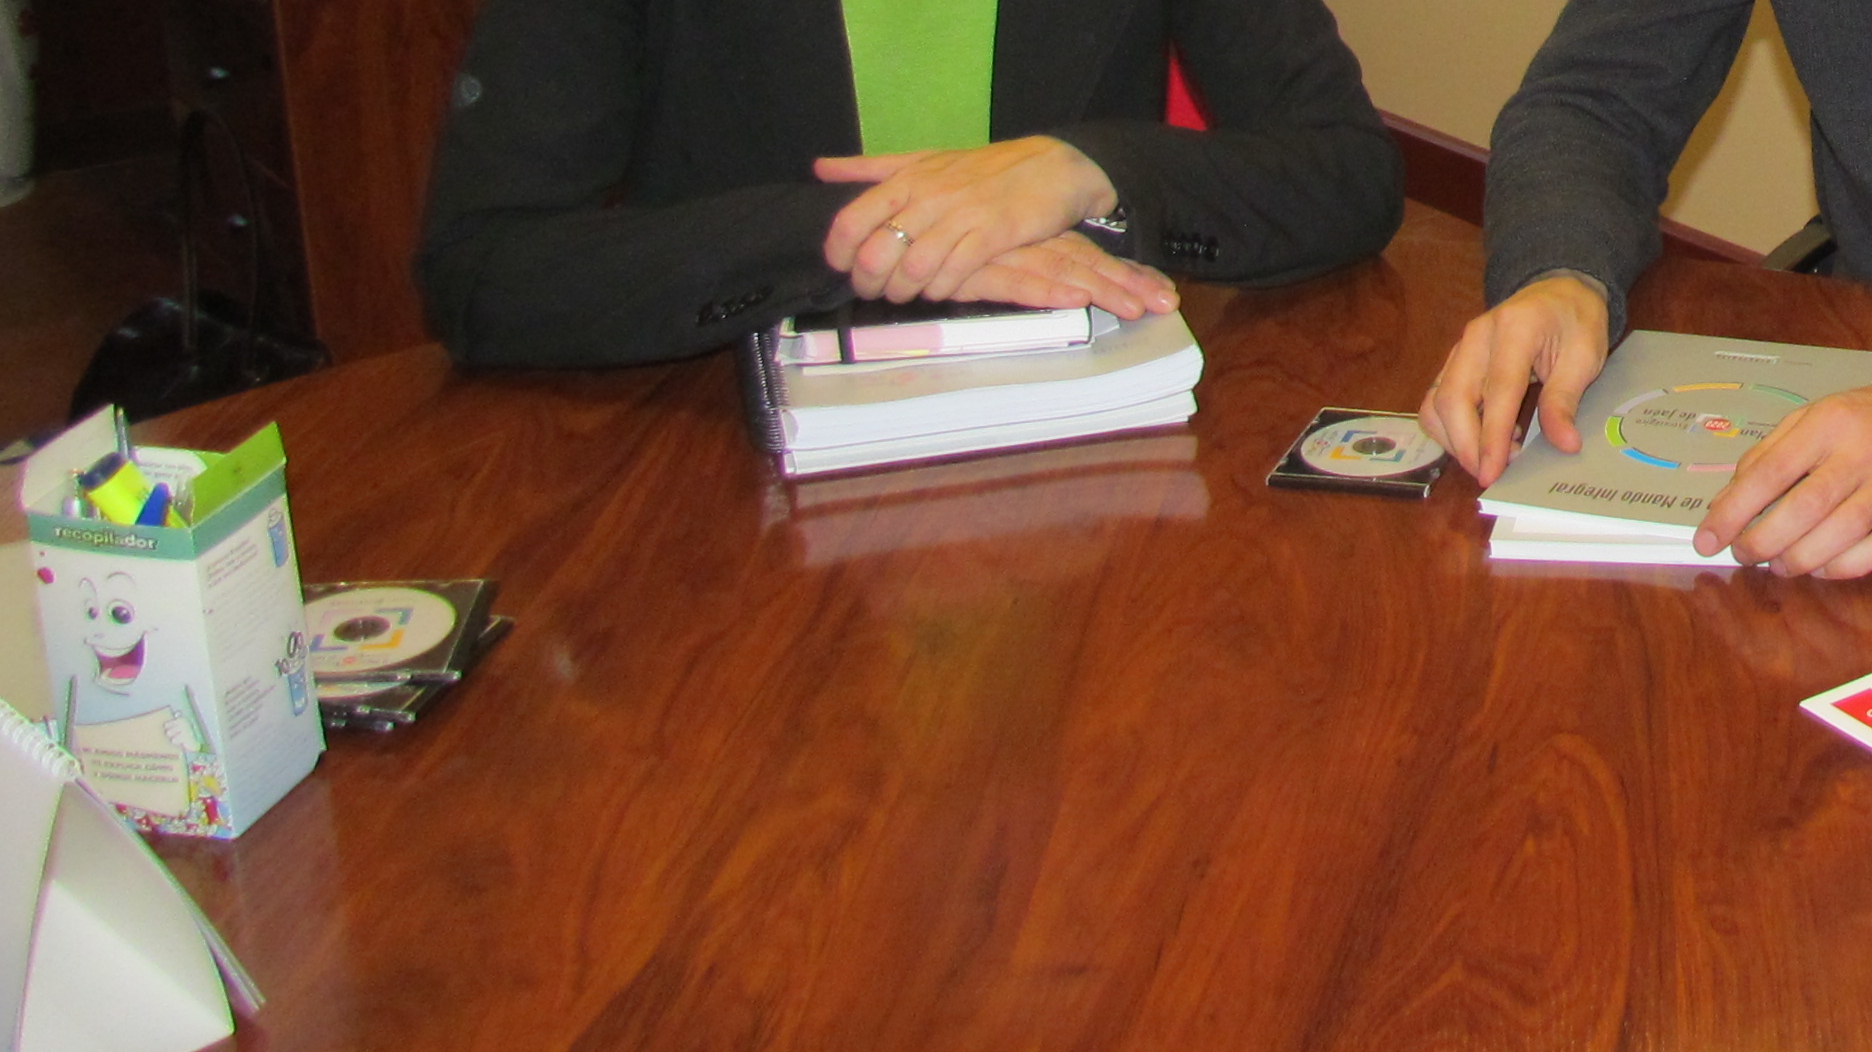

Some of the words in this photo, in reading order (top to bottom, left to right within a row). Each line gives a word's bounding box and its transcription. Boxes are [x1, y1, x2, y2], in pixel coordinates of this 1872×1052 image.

[1548, 481, 1618, 502] Integral
[1621, 490, 1677, 508] Mando
[1680, 497, 1703, 510] de
[54, 527, 157, 550] recopilador
